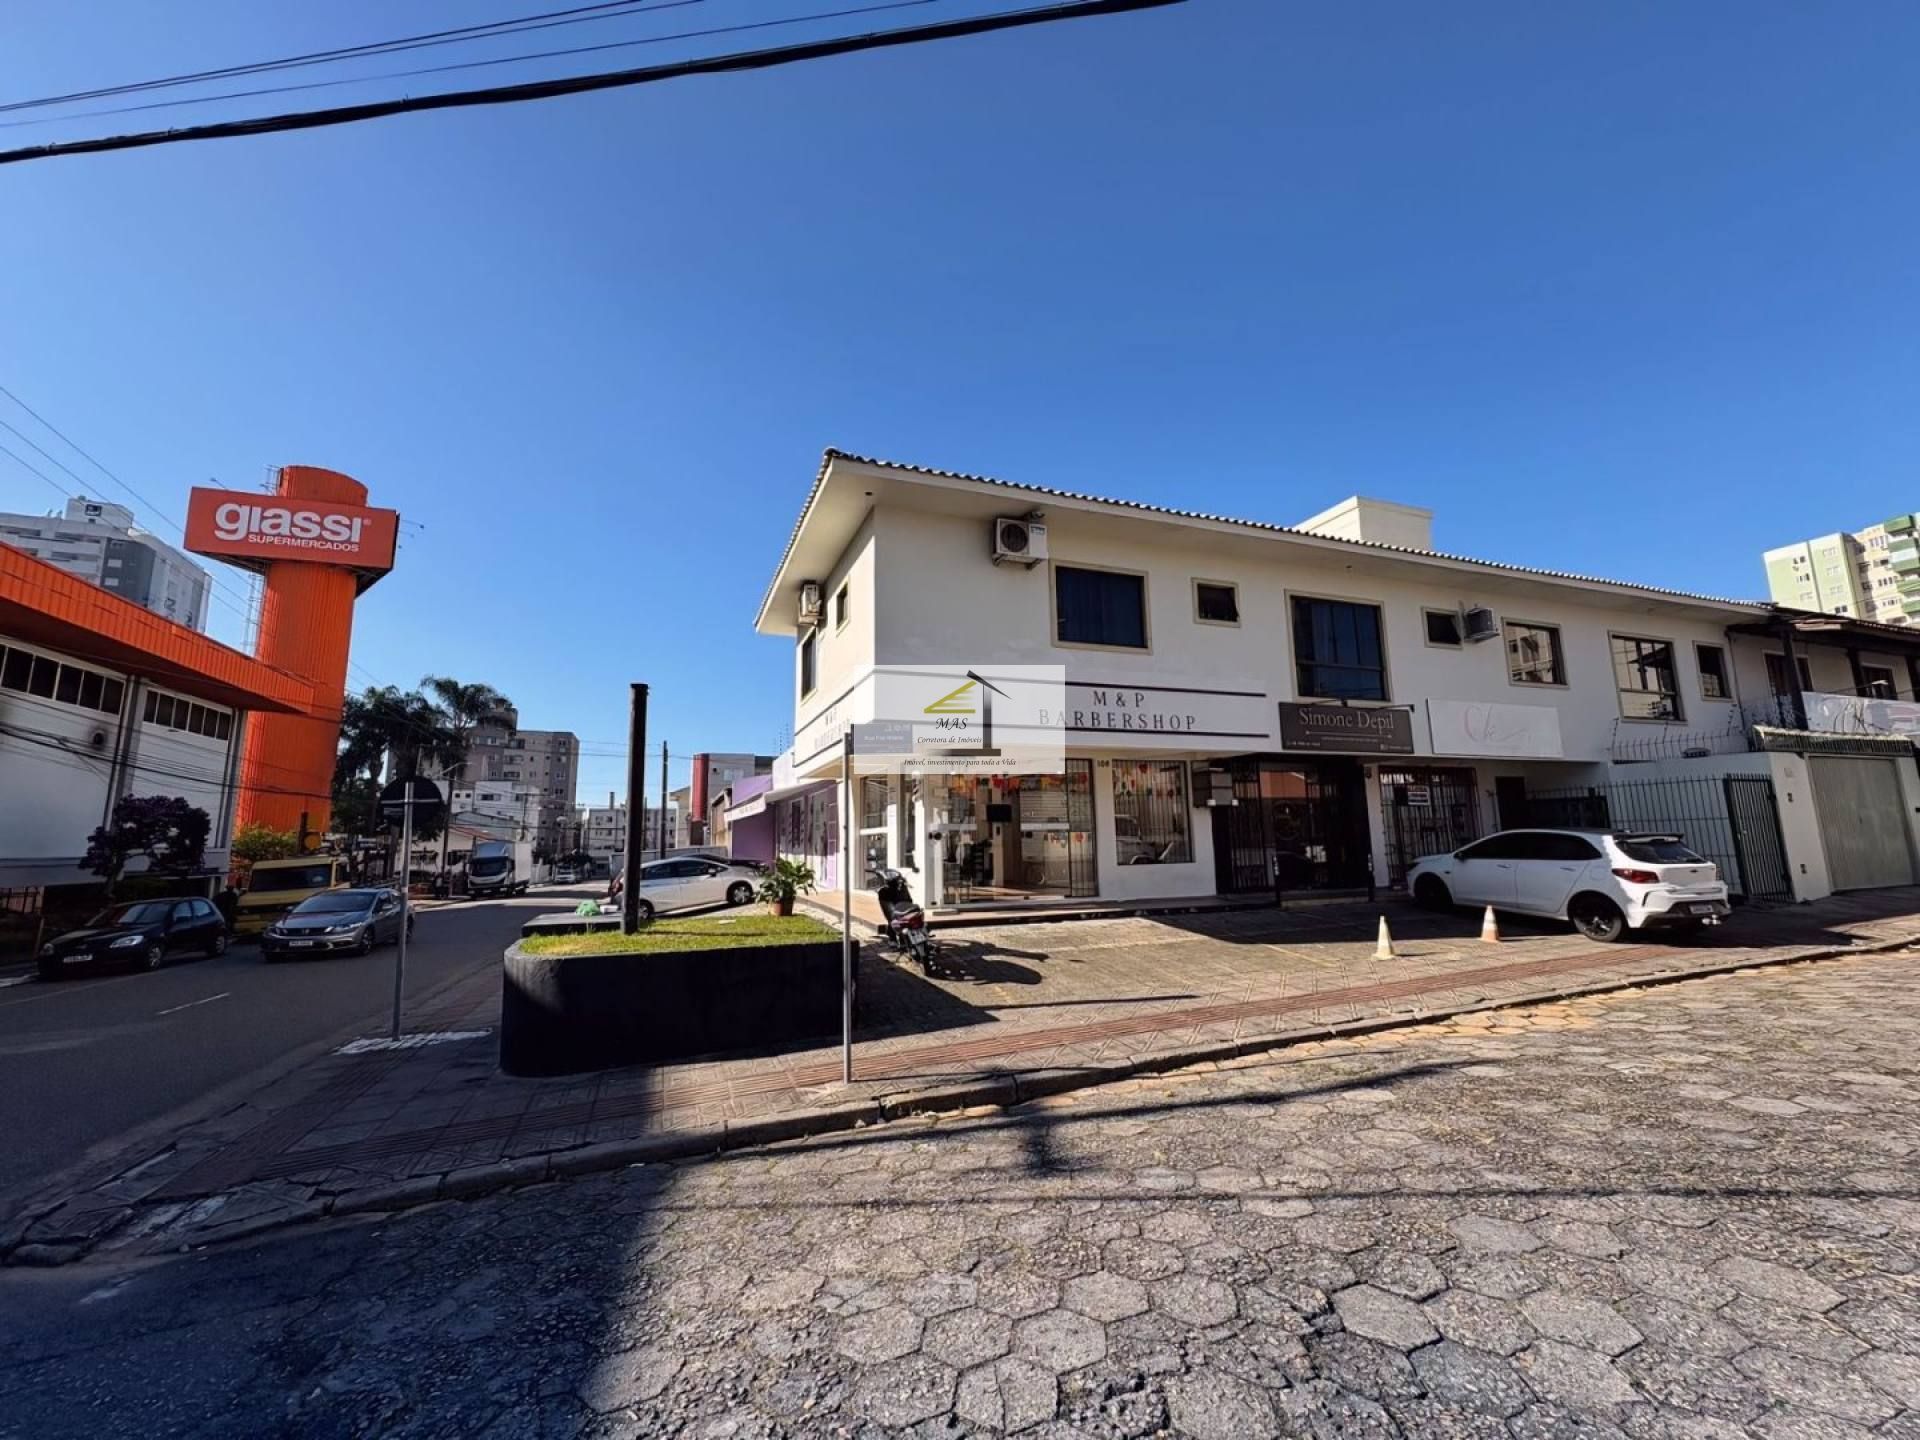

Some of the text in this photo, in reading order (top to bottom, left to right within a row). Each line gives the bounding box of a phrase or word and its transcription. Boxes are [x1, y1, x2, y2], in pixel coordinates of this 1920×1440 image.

[214, 502, 362, 542] giassi
[248, 534, 359, 552] SUPERMERCADOS
[1093, 690, 1145, 708] M & P
[1039, 708, 1196, 730] BARBERSHOP
[1299, 708, 1394, 734] Simone Depil
